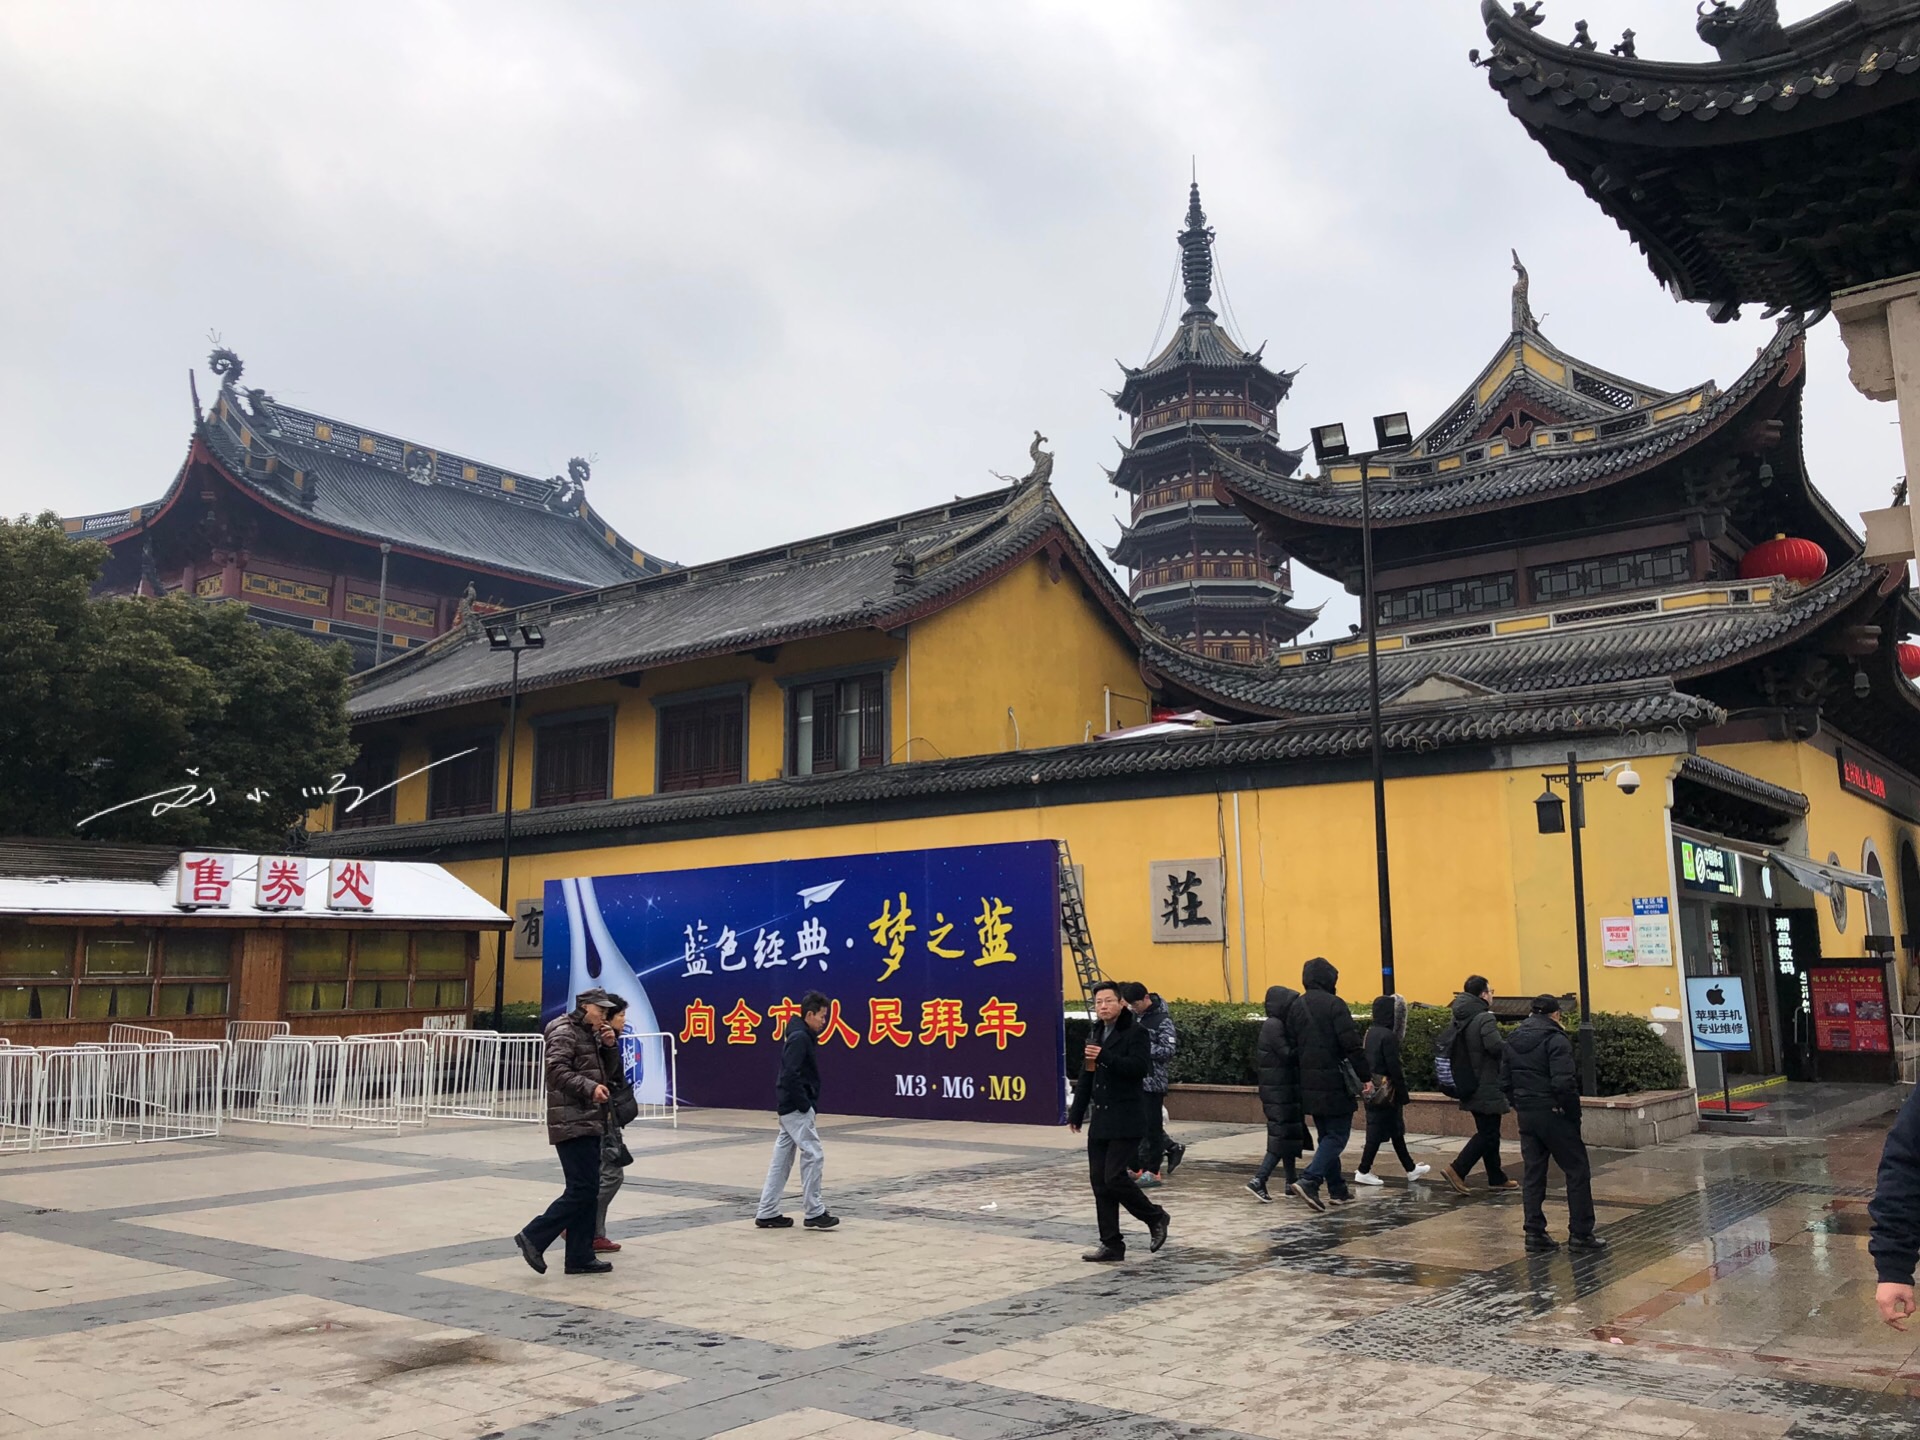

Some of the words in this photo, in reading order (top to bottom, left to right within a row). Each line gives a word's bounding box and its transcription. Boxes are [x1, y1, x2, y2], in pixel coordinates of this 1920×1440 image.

[186, 857, 373, 906] 售券处
[520, 906, 544, 948] 有
[1775, 917, 1795, 976] 潮品数码
[1694, 1009, 1743, 1022] 苹果手机
[1696, 1023, 1744, 1035] 专业维修
